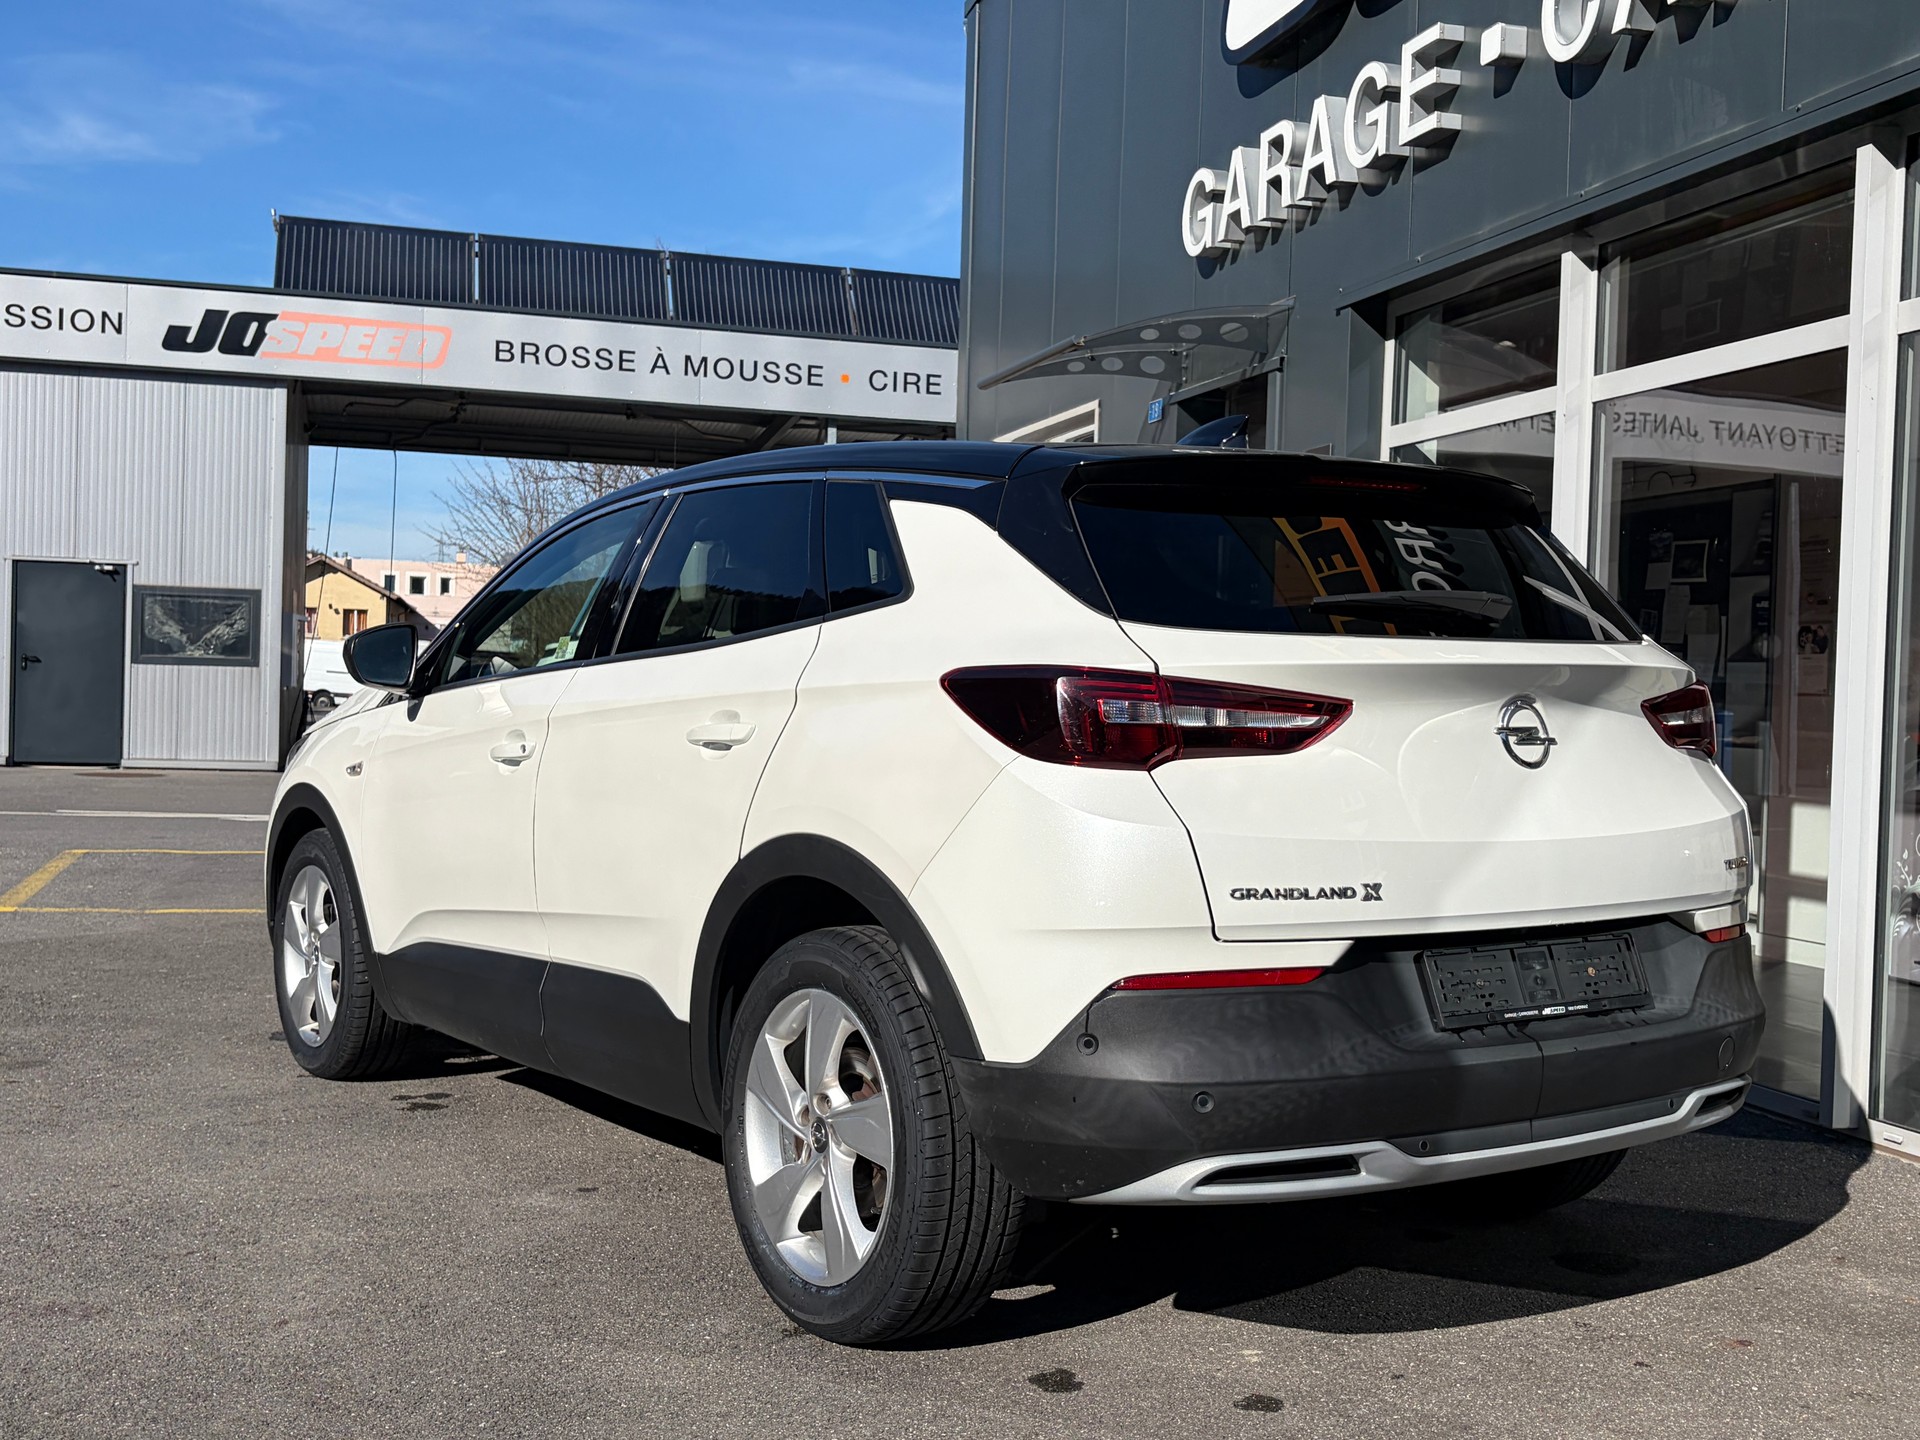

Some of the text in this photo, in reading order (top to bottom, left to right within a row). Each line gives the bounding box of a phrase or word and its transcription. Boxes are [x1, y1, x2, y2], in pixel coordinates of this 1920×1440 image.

[3, 304, 124, 335] SSION
[494, 339, 943, 396] BROSSE À MOUSSE CIRE
[1229, 883, 1384, 901] GRANDLAND X
